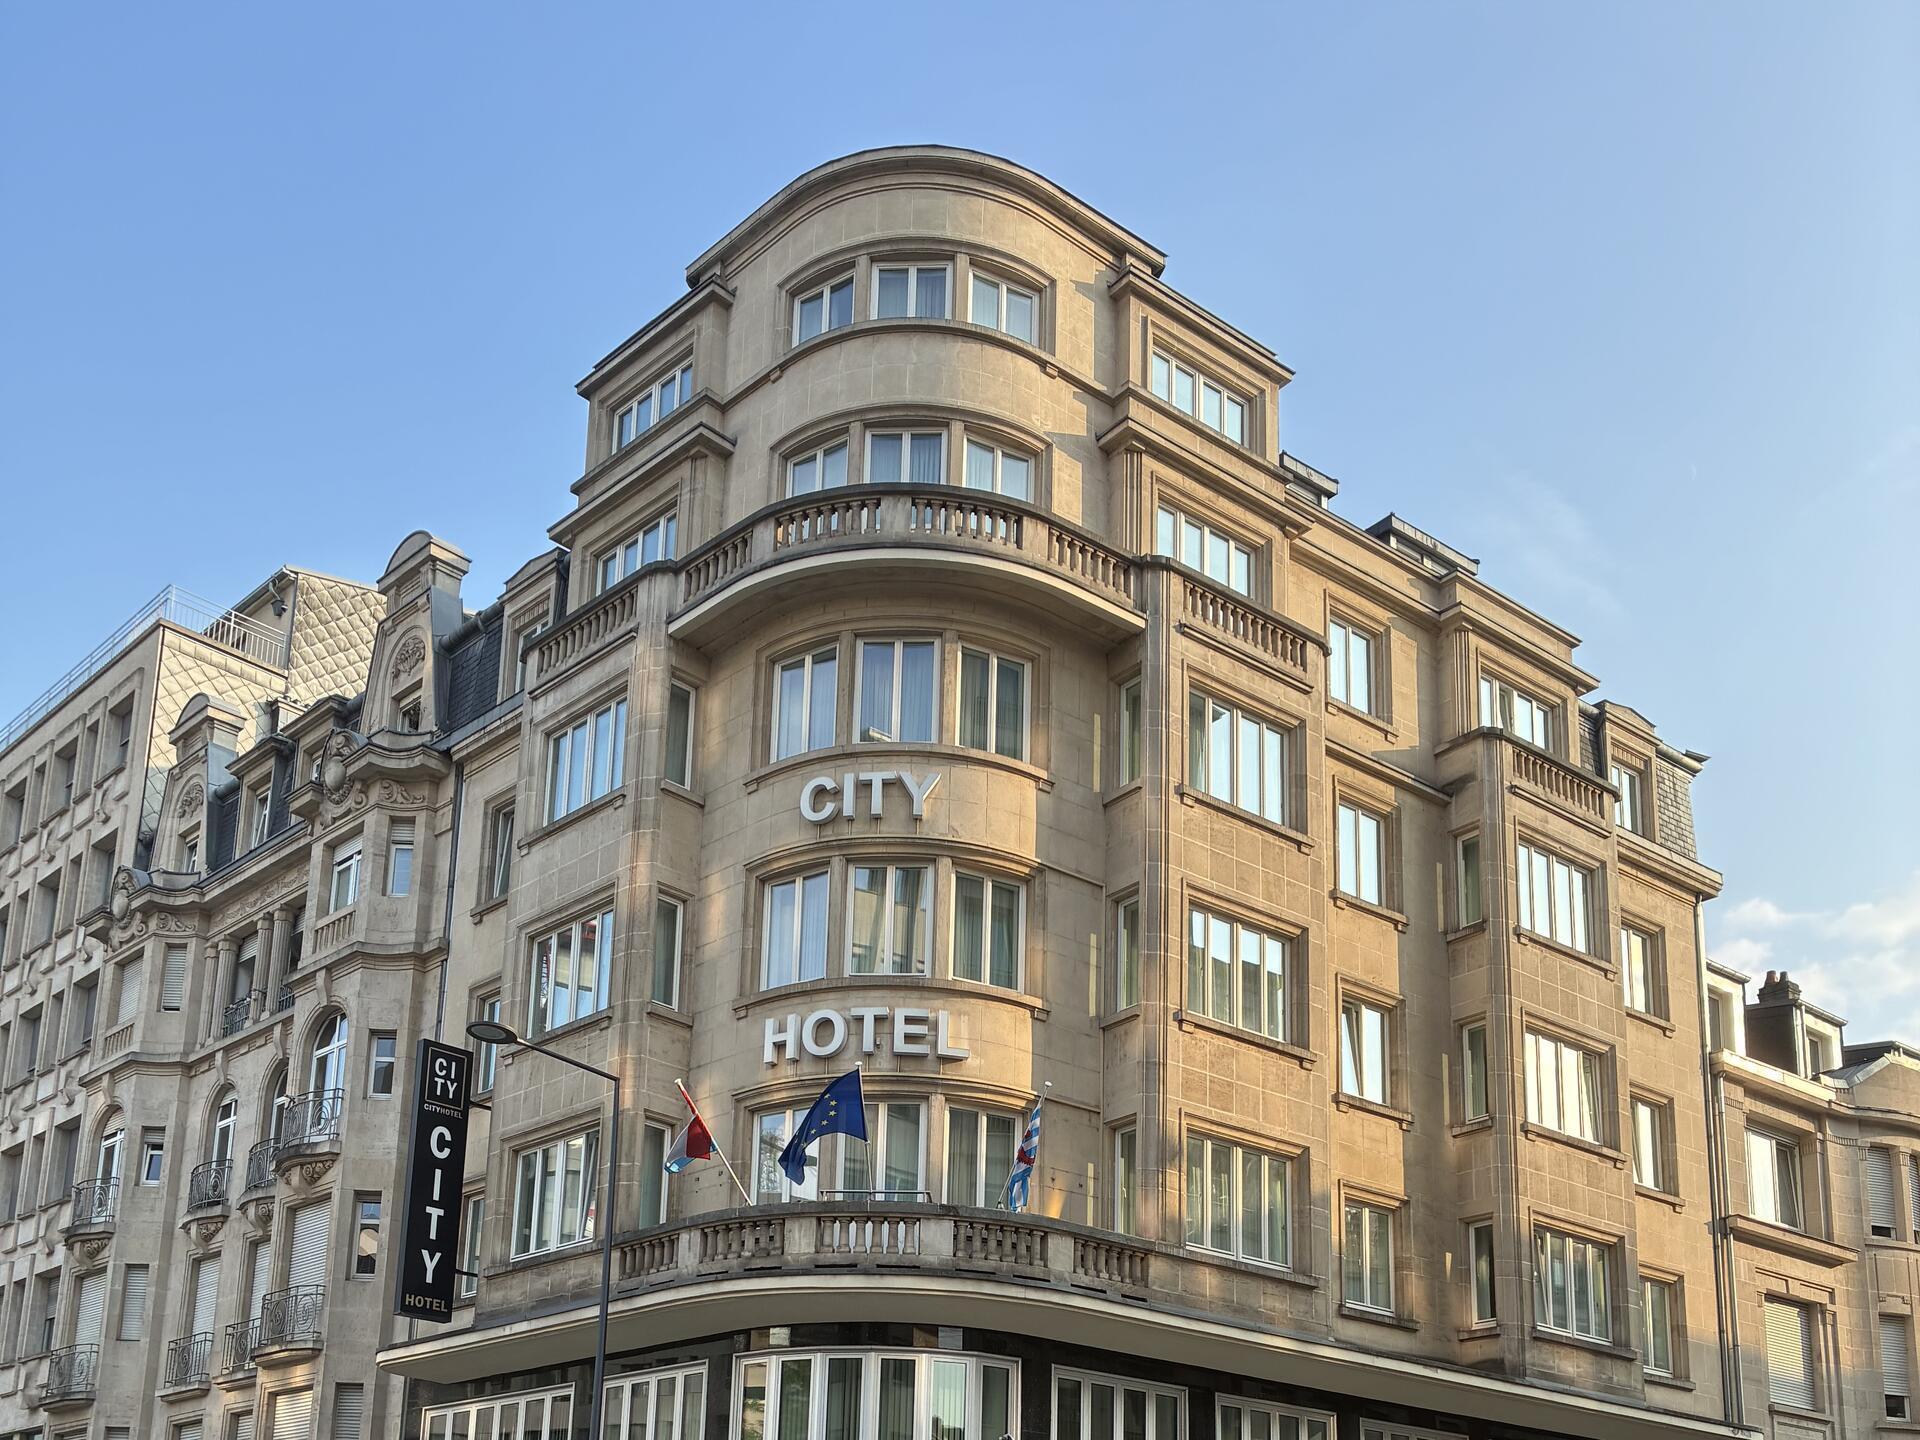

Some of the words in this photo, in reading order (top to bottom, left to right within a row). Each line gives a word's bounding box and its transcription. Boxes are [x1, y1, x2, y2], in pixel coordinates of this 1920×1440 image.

[800, 771, 942, 824] CITY
[763, 1006, 970, 1066] HOTEL
[420, 1125, 452, 1284] CITY
[404, 1293, 448, 1313] HOTEL
